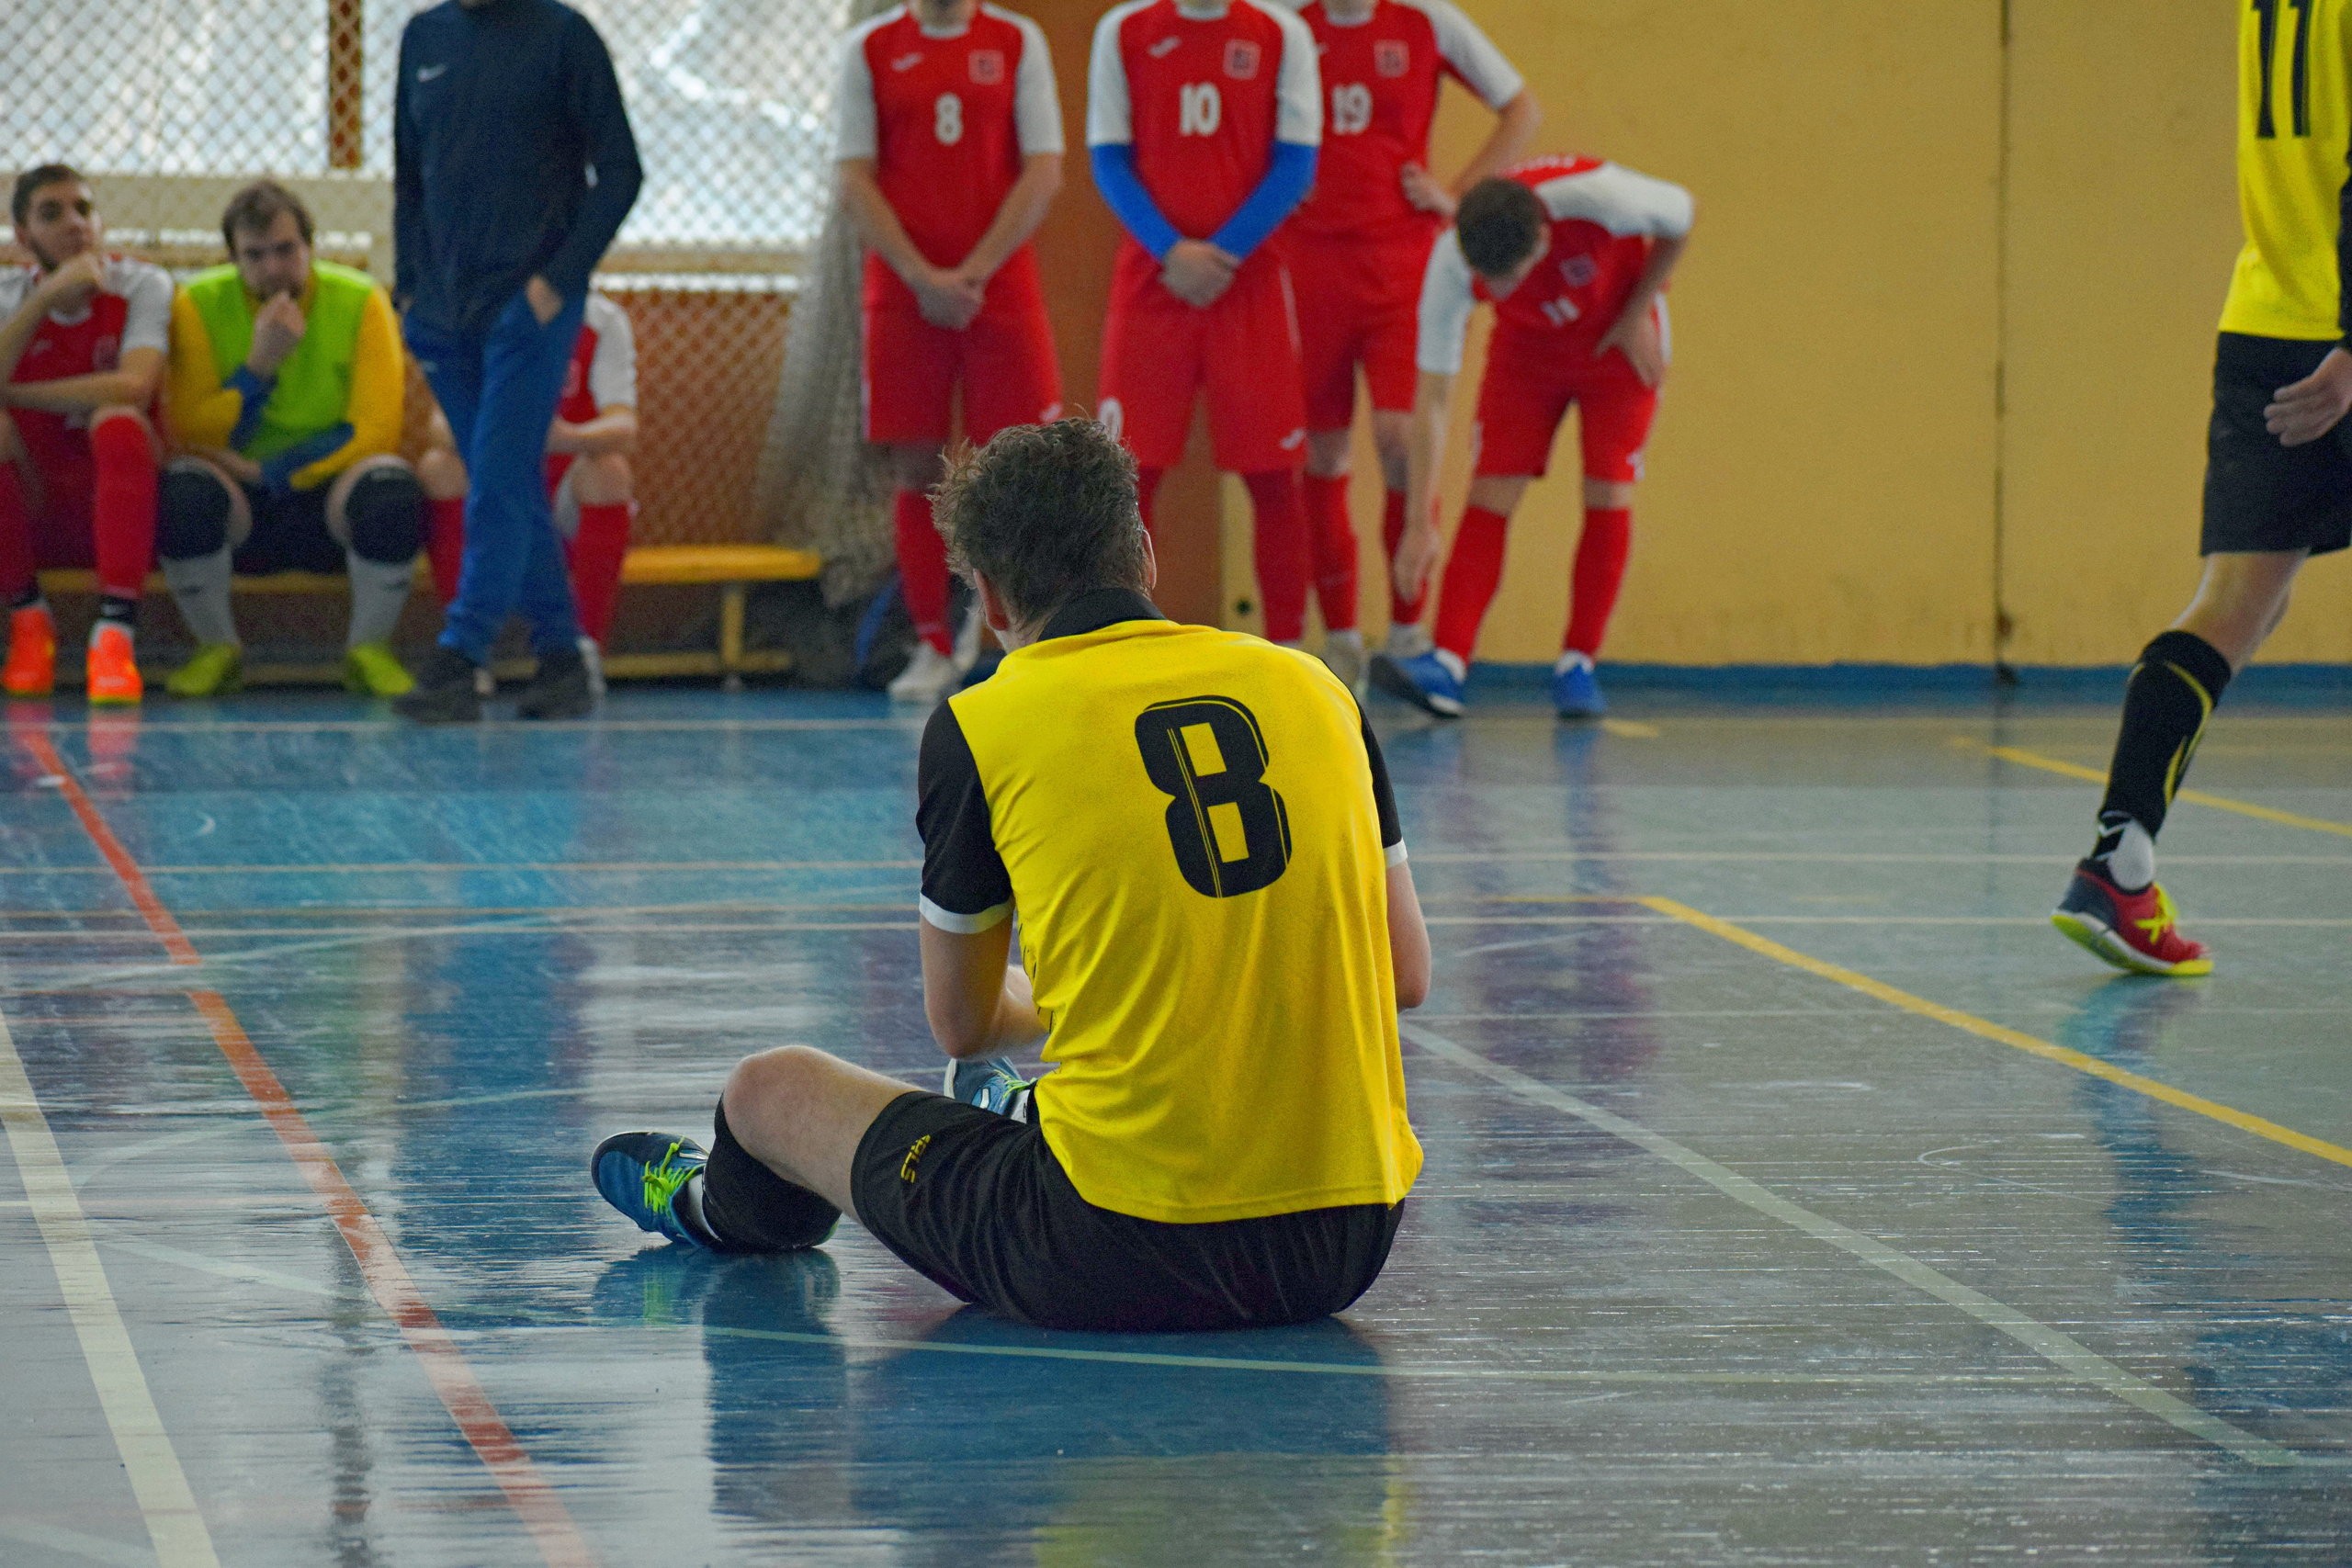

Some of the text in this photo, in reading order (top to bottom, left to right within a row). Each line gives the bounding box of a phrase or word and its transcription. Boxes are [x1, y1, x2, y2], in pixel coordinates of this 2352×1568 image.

[2251, 0, 2311, 138] 11
[934, 93, 963, 145] 8
[1180, 83, 1221, 136] 10
[1331, 83, 1373, 135] 19
[1135, 694, 1293, 898] 8
